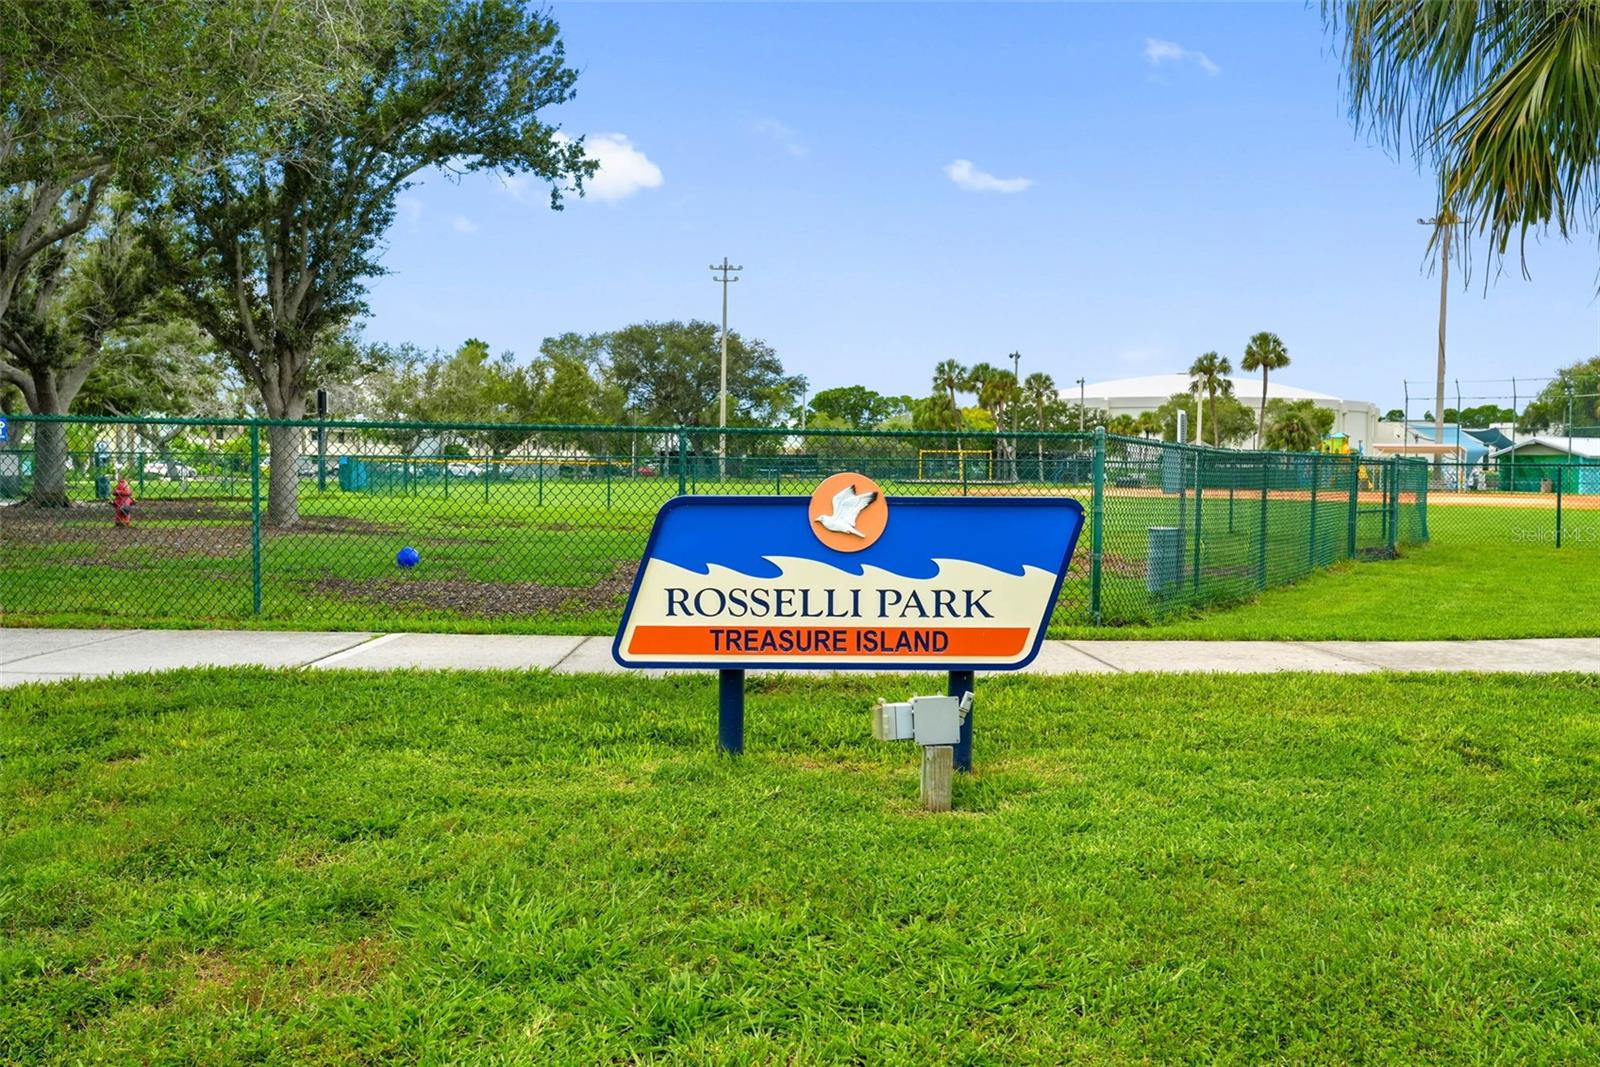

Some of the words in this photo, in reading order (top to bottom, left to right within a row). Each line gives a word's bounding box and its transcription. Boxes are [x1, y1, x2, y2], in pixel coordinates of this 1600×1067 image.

[664, 587, 862, 618] ROSSELLI
[877, 589, 994, 619] PARK
[709, 629, 848, 653] TREASURE
[856, 630, 949, 653] ISLAND
